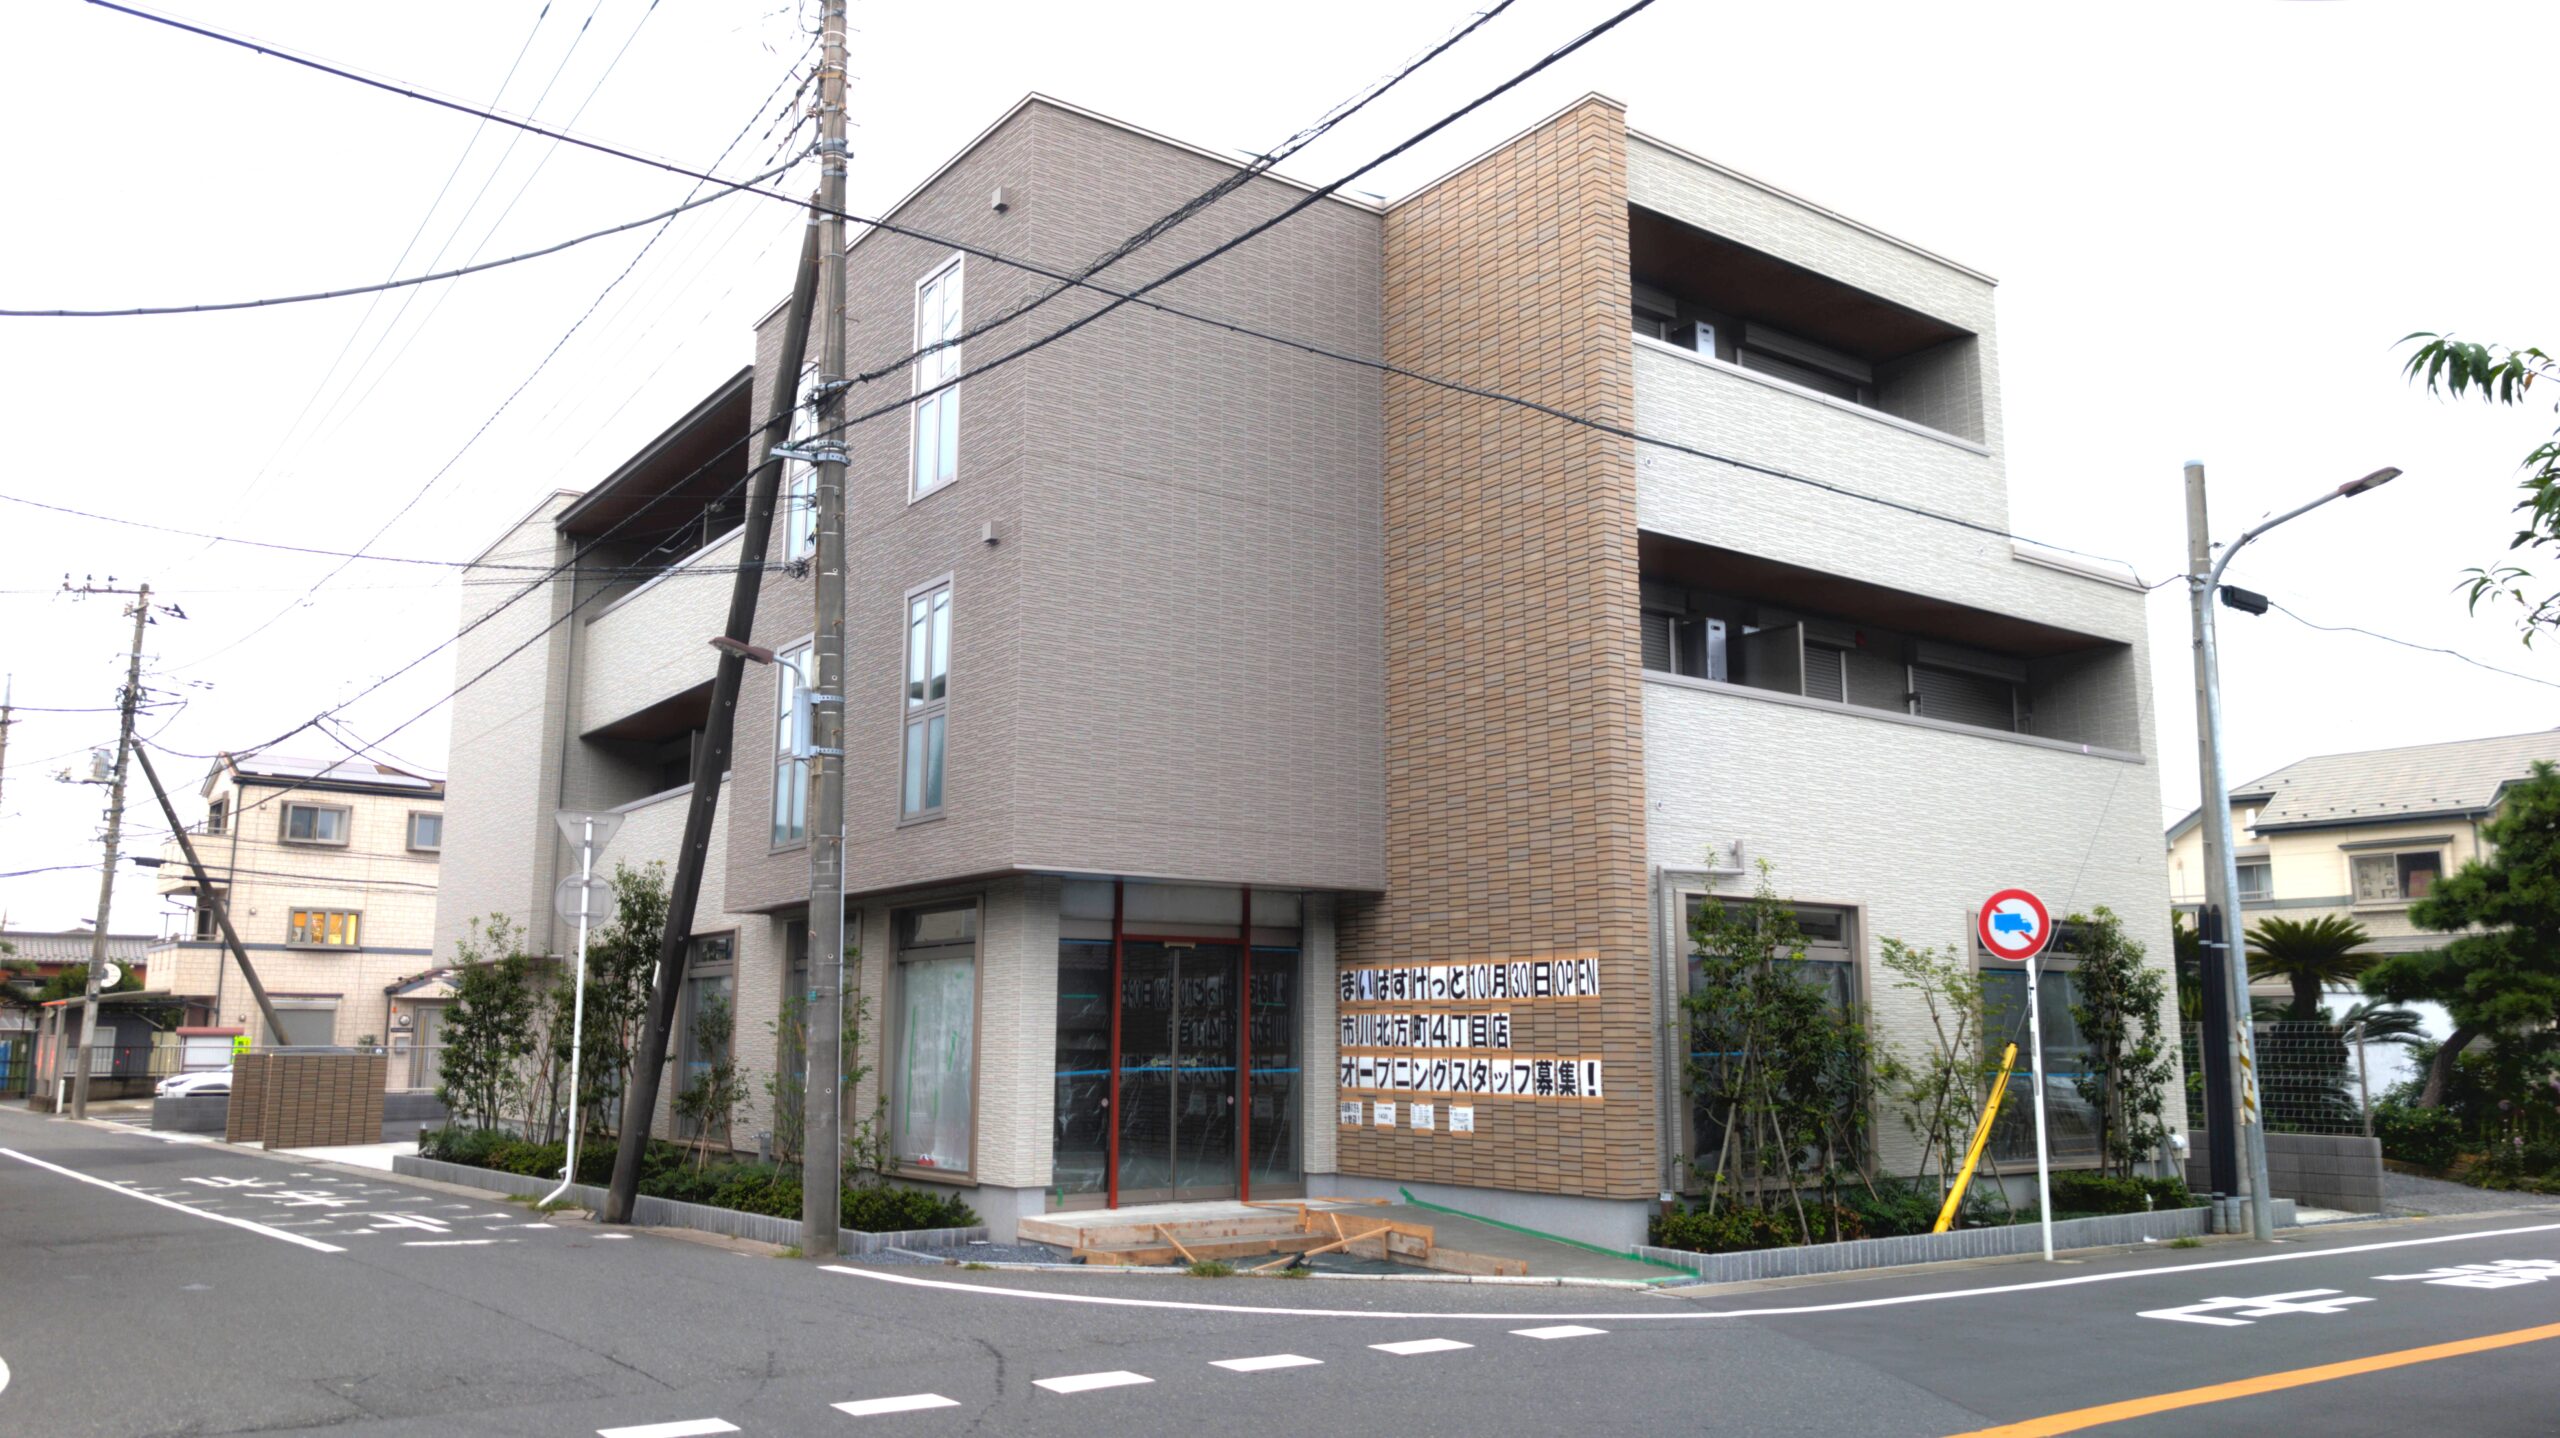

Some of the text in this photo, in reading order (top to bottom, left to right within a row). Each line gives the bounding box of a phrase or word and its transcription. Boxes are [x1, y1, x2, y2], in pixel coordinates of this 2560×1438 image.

[1341, 958, 1597, 1001] まいばすけっと10月30日OPEN
[1341, 1012, 1509, 1049] 市川北方町4丁目店
[1341, 1056, 1597, 1097] オープニングスタッフ募集!
